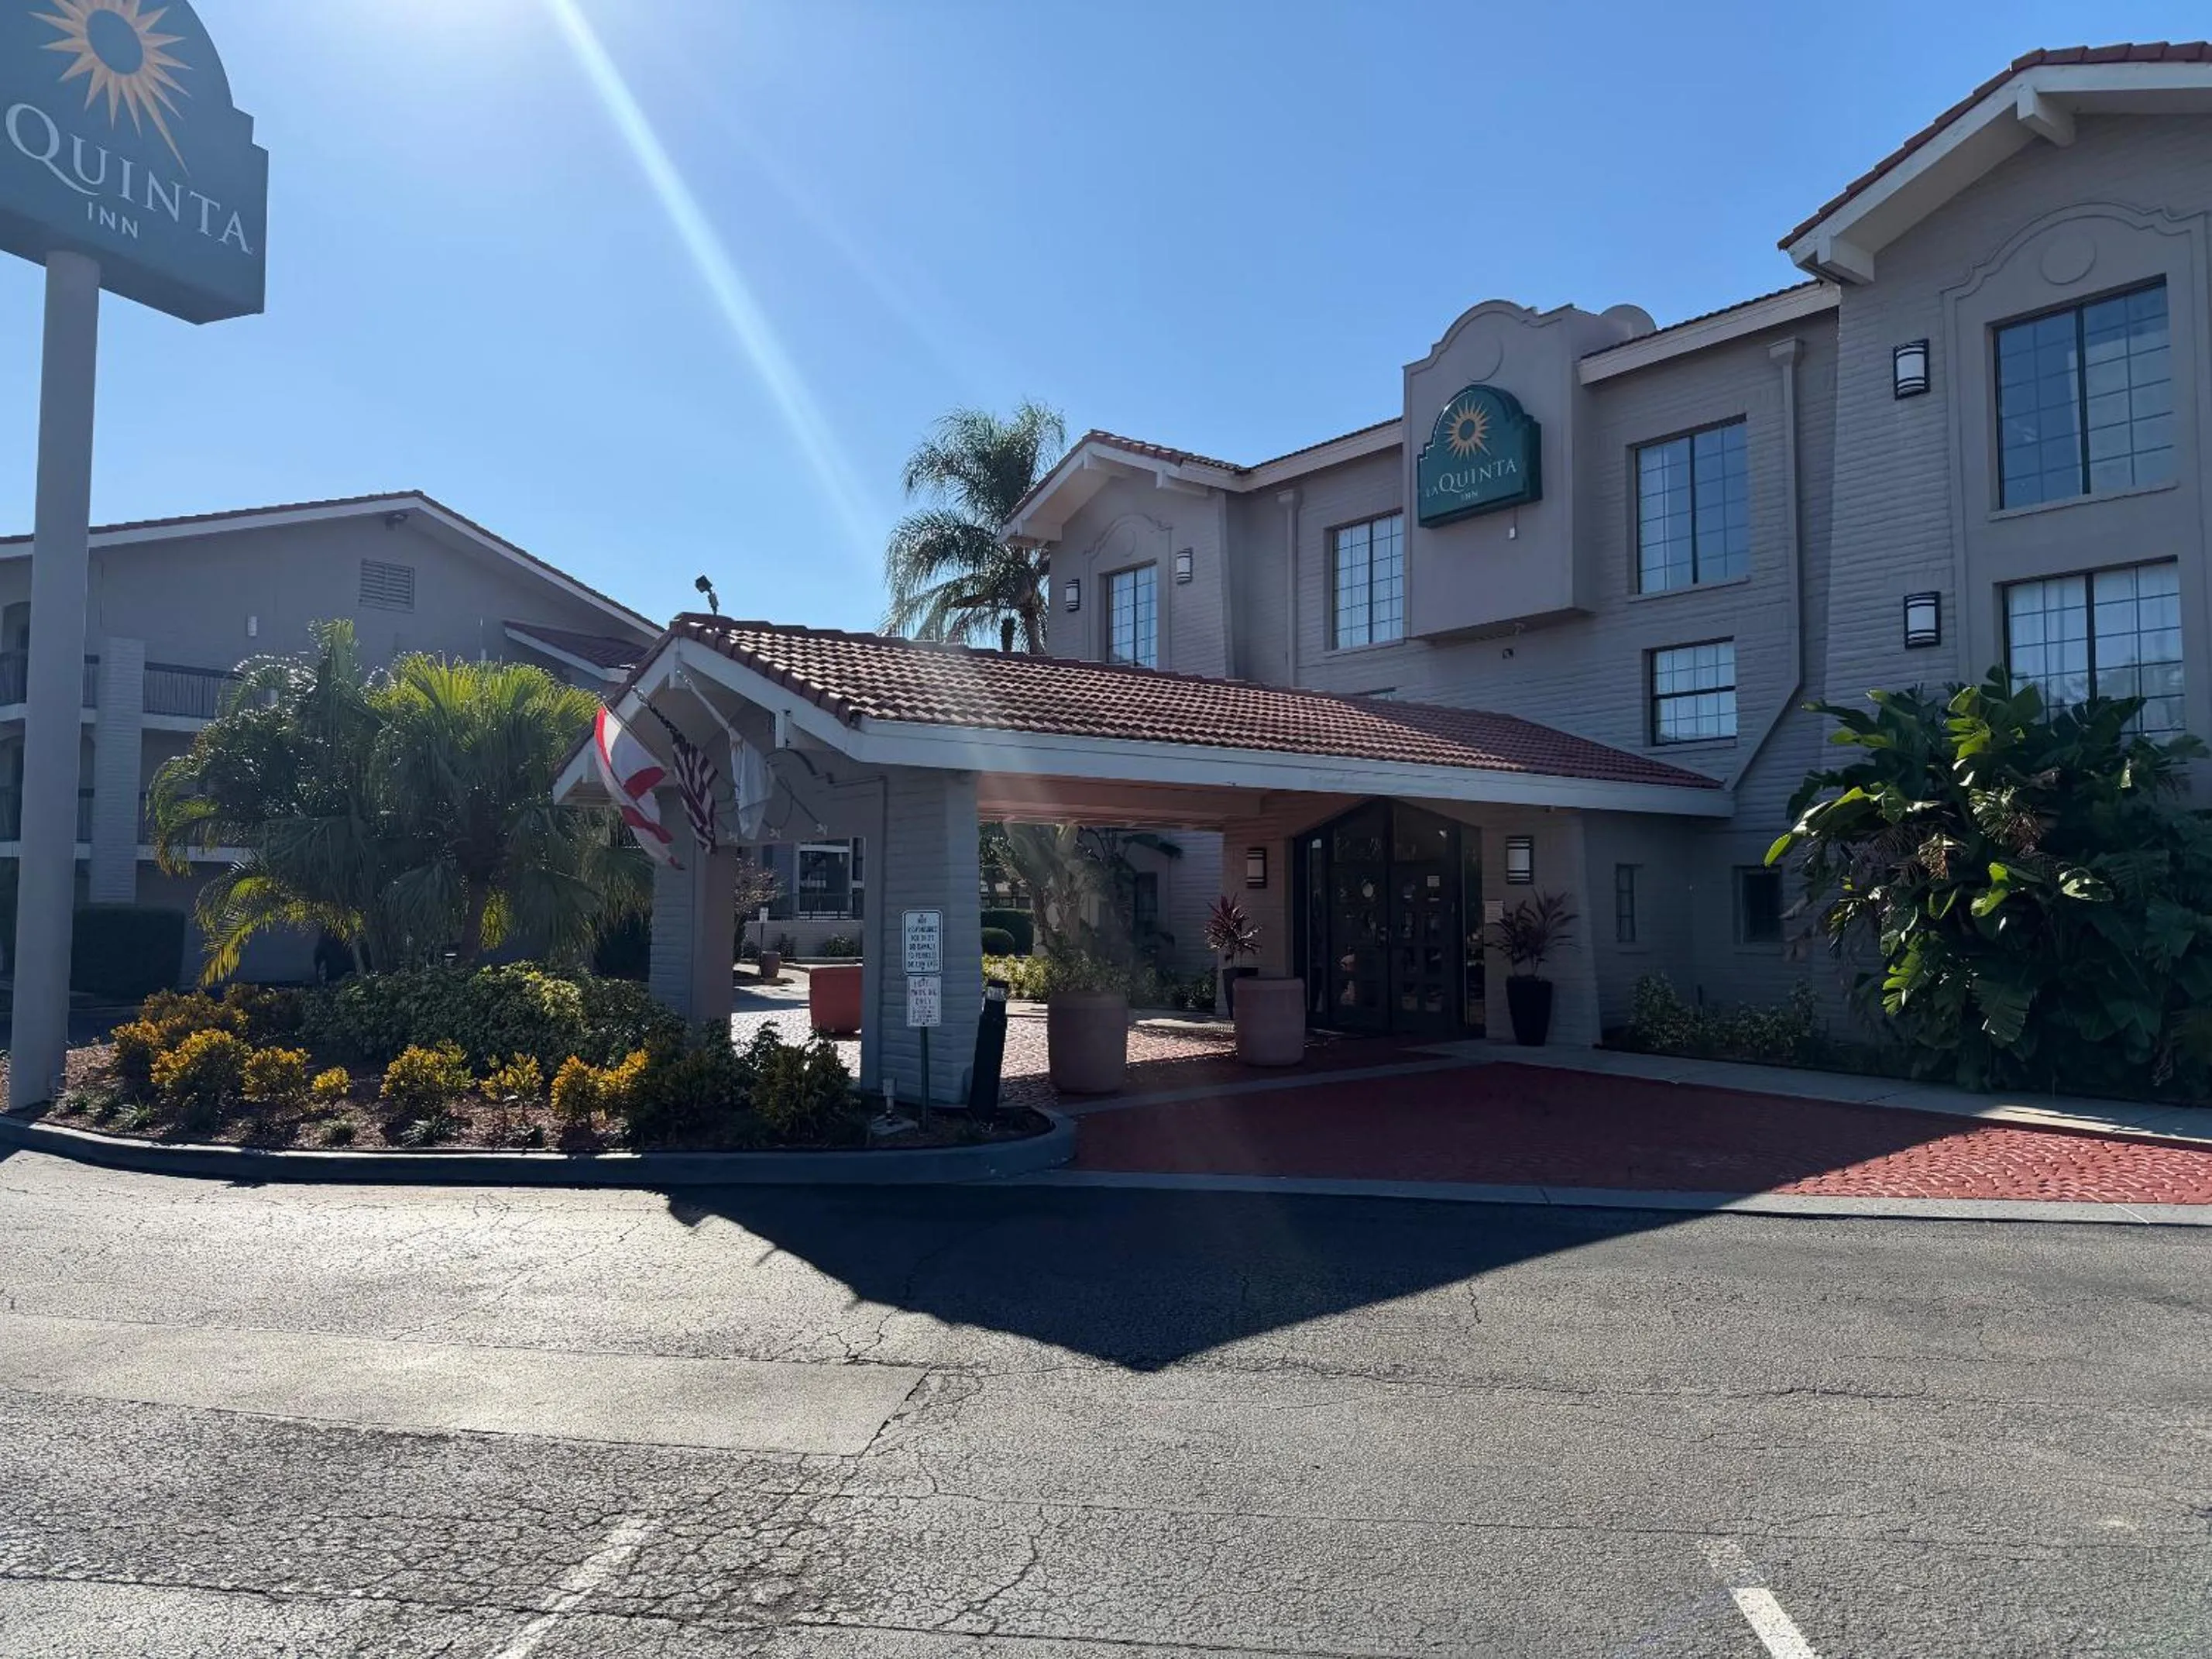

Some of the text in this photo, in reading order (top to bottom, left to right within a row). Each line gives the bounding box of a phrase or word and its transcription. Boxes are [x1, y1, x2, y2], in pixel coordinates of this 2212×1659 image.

[5, 102, 255, 256] QUINTA
[87, 201, 139, 239] INN
[1438, 459, 1517, 493] QUINTA
[1460, 490, 1479, 500] INN
